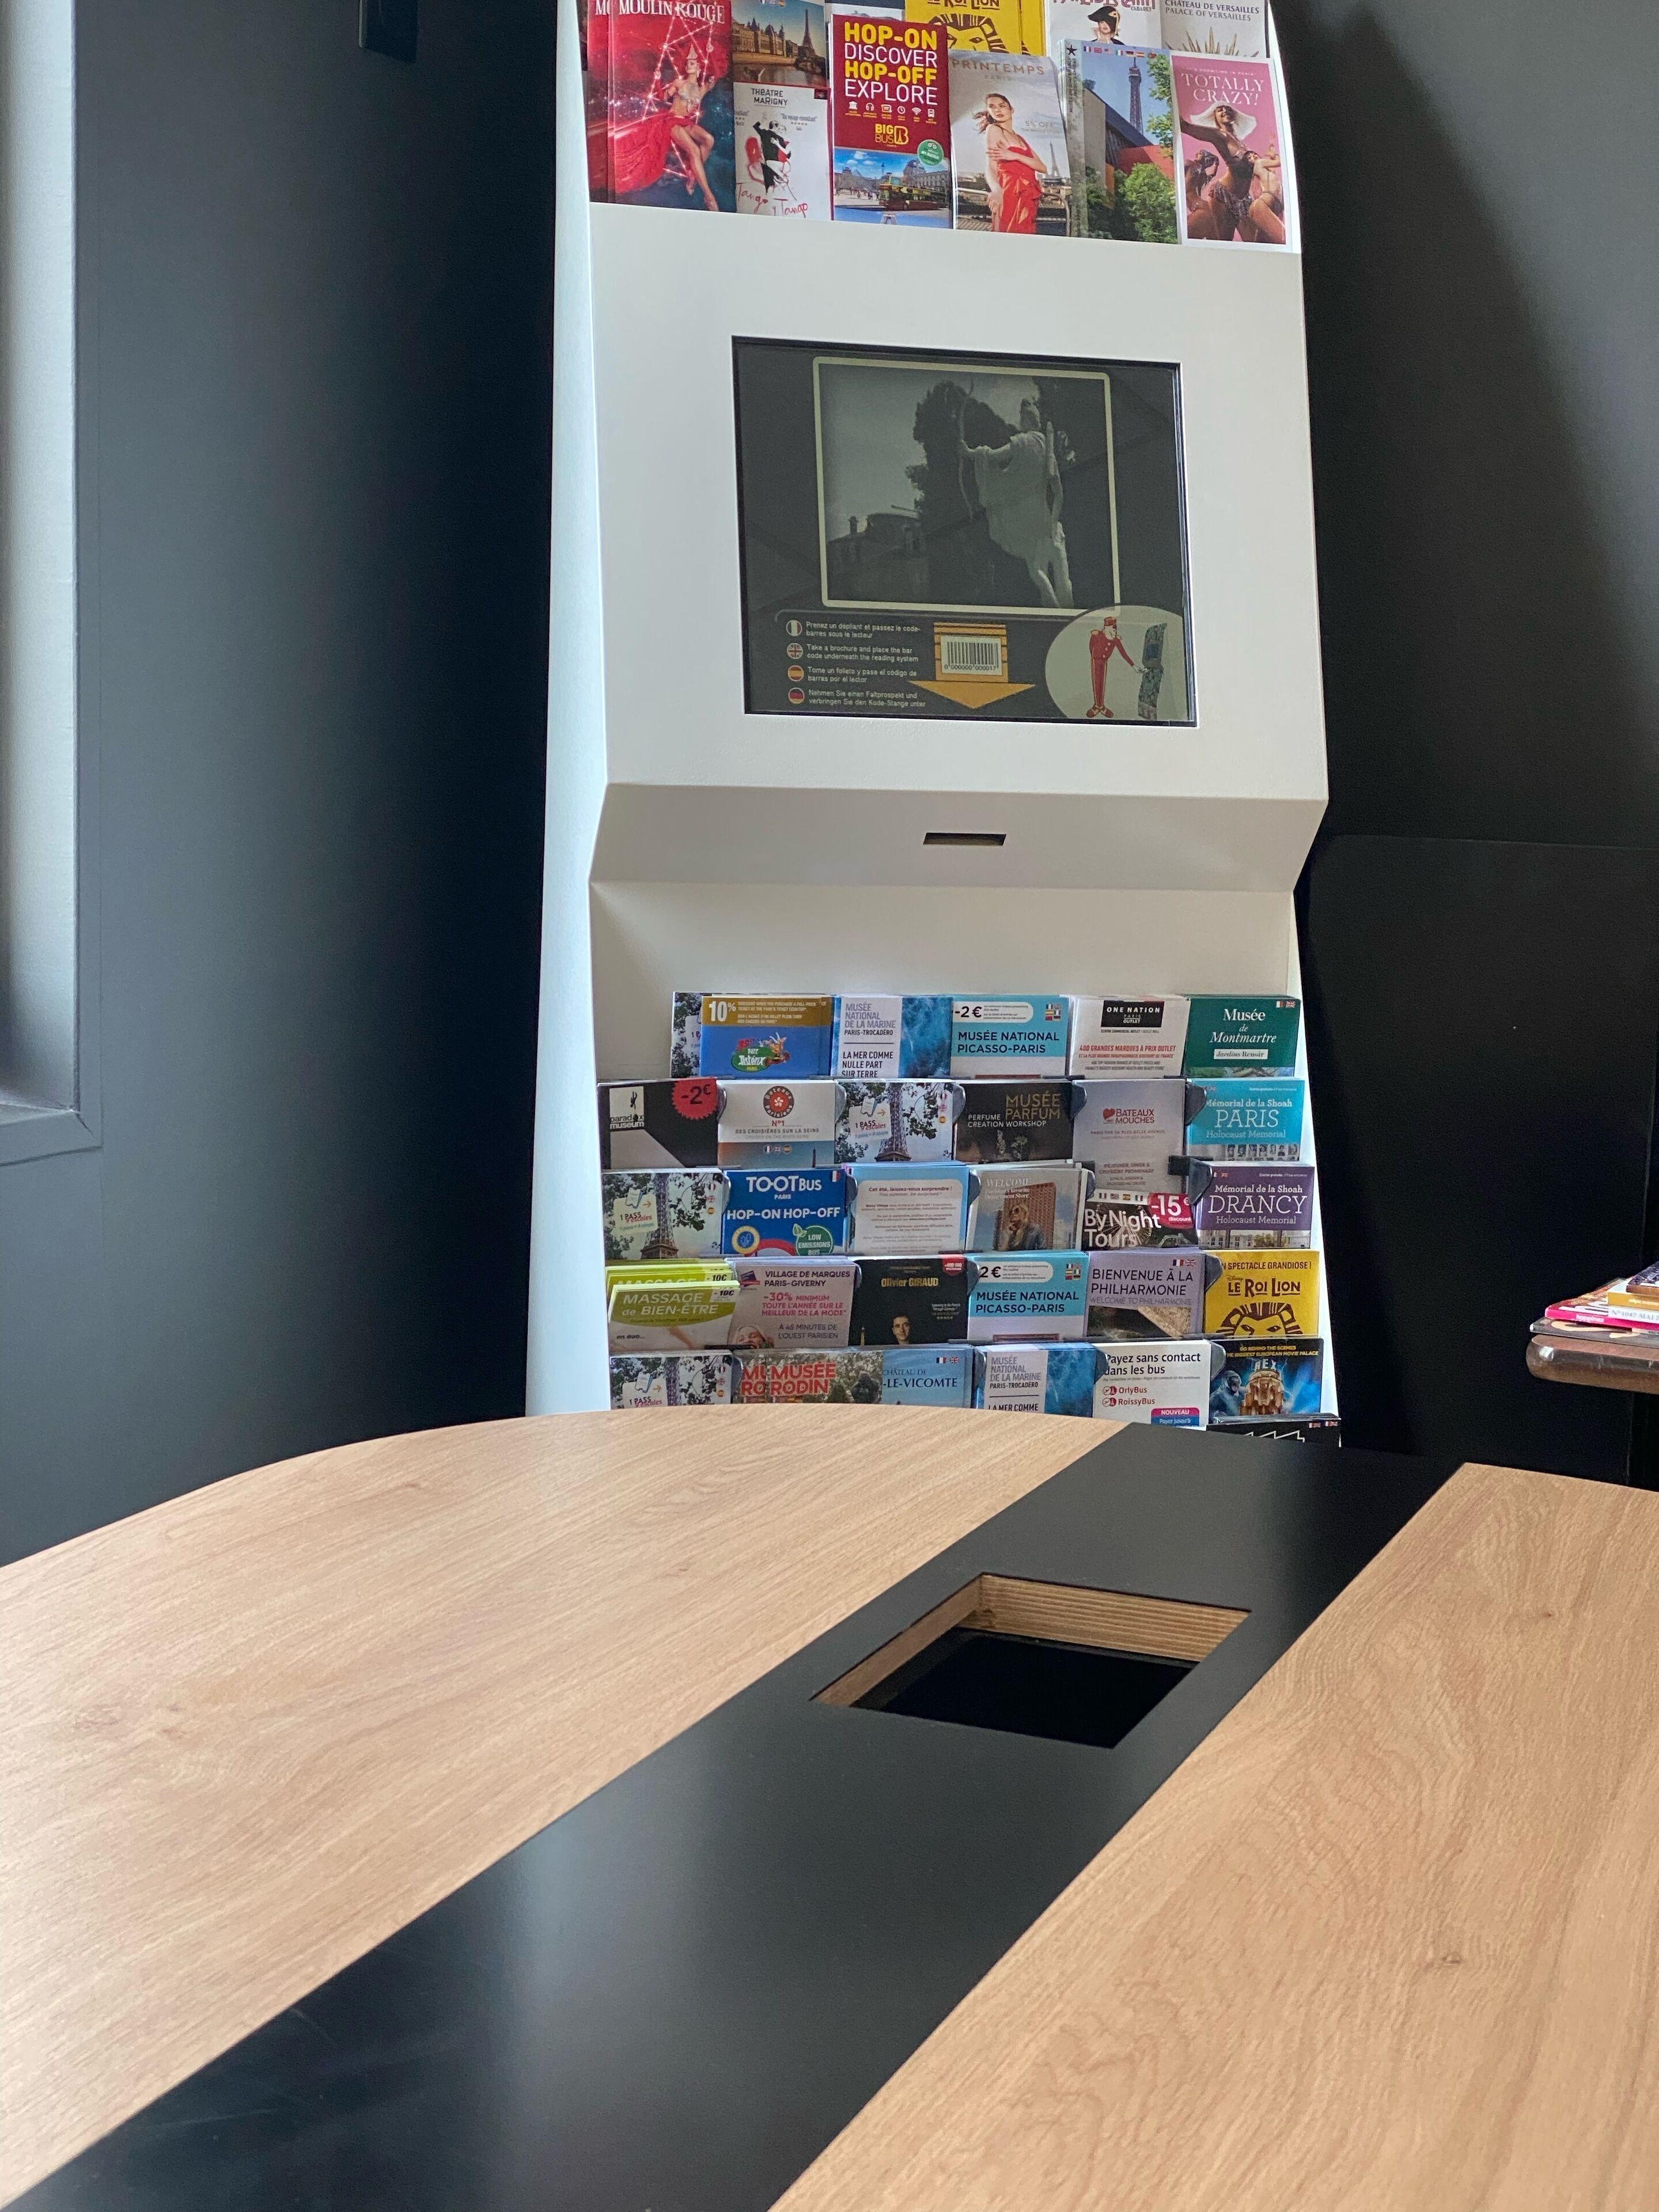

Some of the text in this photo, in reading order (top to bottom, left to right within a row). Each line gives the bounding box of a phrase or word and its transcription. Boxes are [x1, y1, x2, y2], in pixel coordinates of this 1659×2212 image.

[619, 0, 672, 15] MOULIN
[676, 2, 725, 24] ROUGE
[1165, 7, 1194, 16] PALACE
[1209, 12, 1251, 21] VERSAILLES
[1216, 4, 1260, 14] VERSAILLES
[844, 21, 937, 50] HOP-ON
[844, 43, 937, 68] DISCOVER
[845, 60, 937, 85] HOP-OFF
[952, 59, 1045, 75] PRINTEMPS
[1181, 73, 1264, 92] TOTALLY
[845, 79, 938, 105] EXPLORE
[1194, 89, 1258, 105] CRAZY!
[753, 97, 788, 106] MARIGNY
[875, 123, 893, 134] BIG
[875, 134, 893, 144] BUS
[846, 1002, 872, 1012] MUSÉE
[1223, 1008, 1266, 1021] Musée
[868, 1020, 896, 1028] MARINE
[1239, 1024, 1248, 1032] de
[958, 1030, 1060, 1041] MUSÉE NATIONAL
[1210, 1032, 1277, 1043] Montmartre
[957, 1044, 1046, 1053] PICASSO-PARIS
[738, 1055, 766, 1066] Astérix
[1006, 1090, 1061, 1108] MUSÉE
[1206, 1099, 1243, 1107] Mémorial
[1267, 1099, 1293, 1107] Shoah
[1006, 1108, 1060, 1120] PARFUM
[1116, 1108, 1154, 1117] BATEAUX
[1215, 1109, 1279, 1127] PARIS
[1206, 1130, 1286, 1138] Holocaust Memorial
[1215, 1184, 1302, 1193] Mémorial de la Shoah
[1208, 1195, 1307, 1214] DRANCY
[726, 1207, 840, 1219] HOP-ON HOP-OFF
[1085, 1209, 1161, 1232] By Night
[1216, 1216, 1296, 1224] Holocaust Memorial
[1085, 1229, 1138, 1247] Tours
[1093, 1268, 1193, 1281] BIENVENUE LA
[881, 1278, 939, 1286] Olivier GIRAUD
[1228, 1282, 1241, 1293] LE
[1091, 1283, 1187, 1296] PHILHARMONIE
[623, 1293, 703, 1304] MASSAGE
[976, 1290, 1079, 1301] MUSÉE NATIONAL
[1090, 1296, 1126, 1304] WELCOME
[641, 1302, 718, 1316] BIEN-ÊTRE
[976, 1304, 1065, 1313] PICASSO-PARIS
[991, 1356, 1018, 1365] MUSÉE
[1136, 1353, 1201, 1363] sans contact
[771, 1361, 836, 1380] MUSÉE
[1131, 1365, 1165, 1374] les bus
[1002, 1373, 1010, 1381] LA
[1012, 1373, 1041, 1381] MARINE
[771, 1379, 829, 1395] RODIN
[1119, 1387, 1147, 1395] OrlyBus
[634, 1396, 652, 1404] PASS
[1118, 1398, 1155, 1406] RoissyBus
